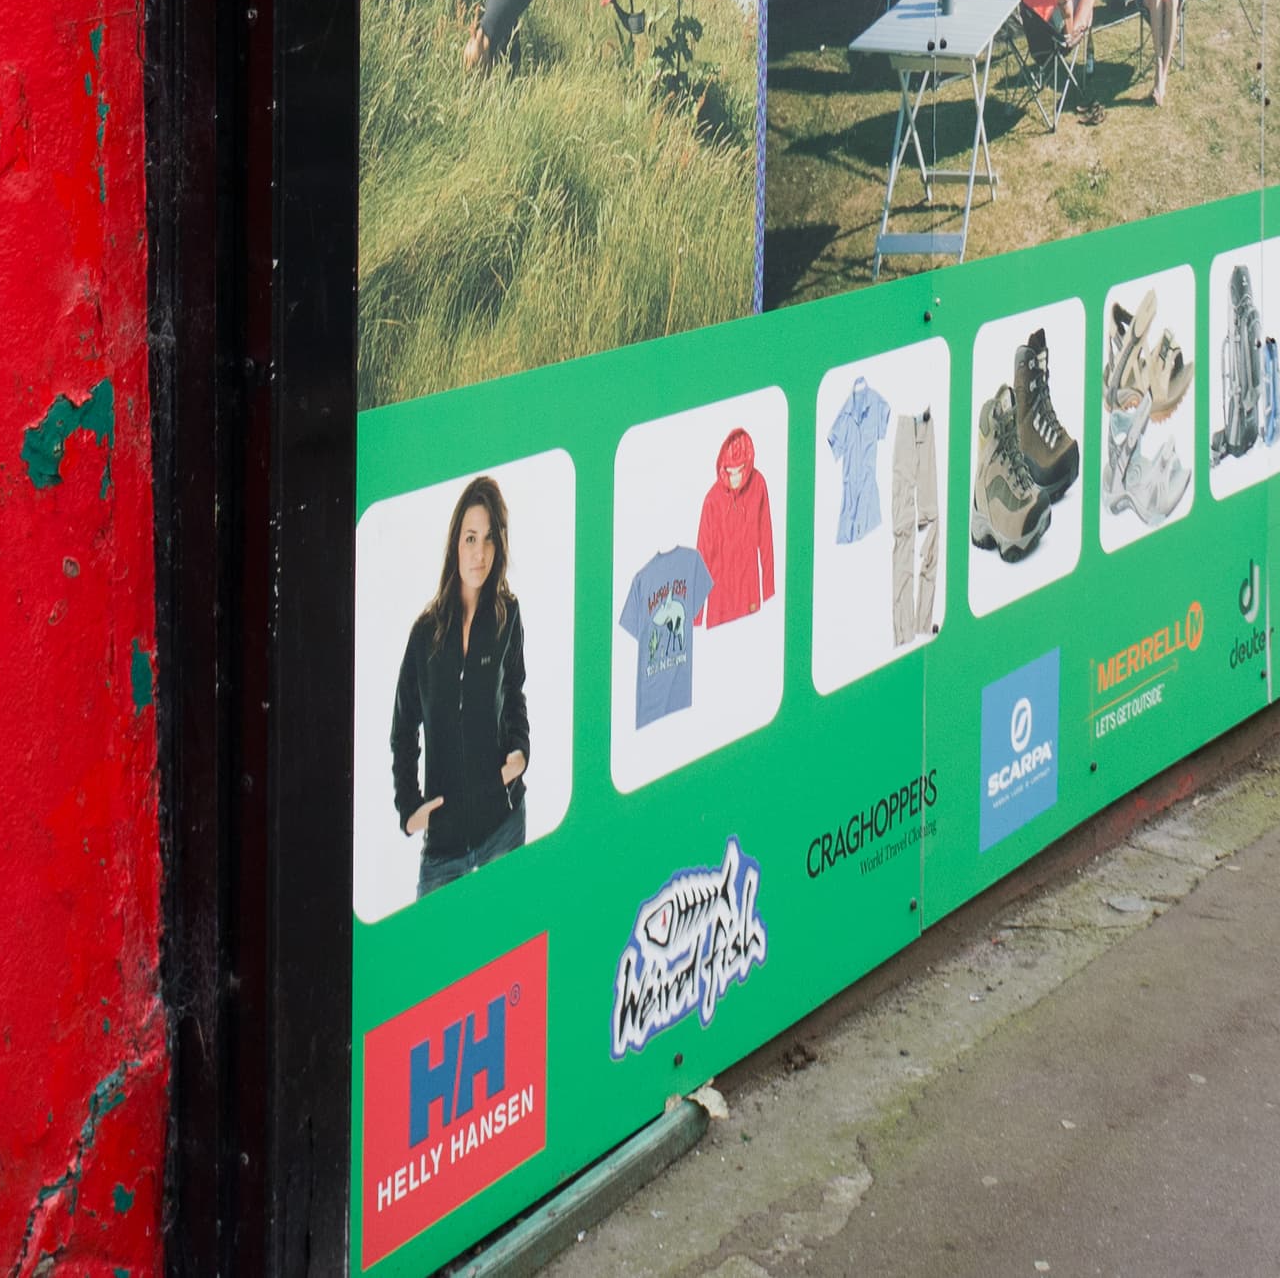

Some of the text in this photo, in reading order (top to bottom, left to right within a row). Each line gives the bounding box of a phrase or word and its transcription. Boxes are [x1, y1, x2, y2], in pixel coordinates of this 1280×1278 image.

[1097, 620, 1186, 695] MERRELL
[987, 740, 1053, 798] SCARPA
[806, 768, 938, 879] CRAGHOPPERS
[860, 846, 885, 876] World
[377, 1083, 535, 1213] HELLY HANSEN
